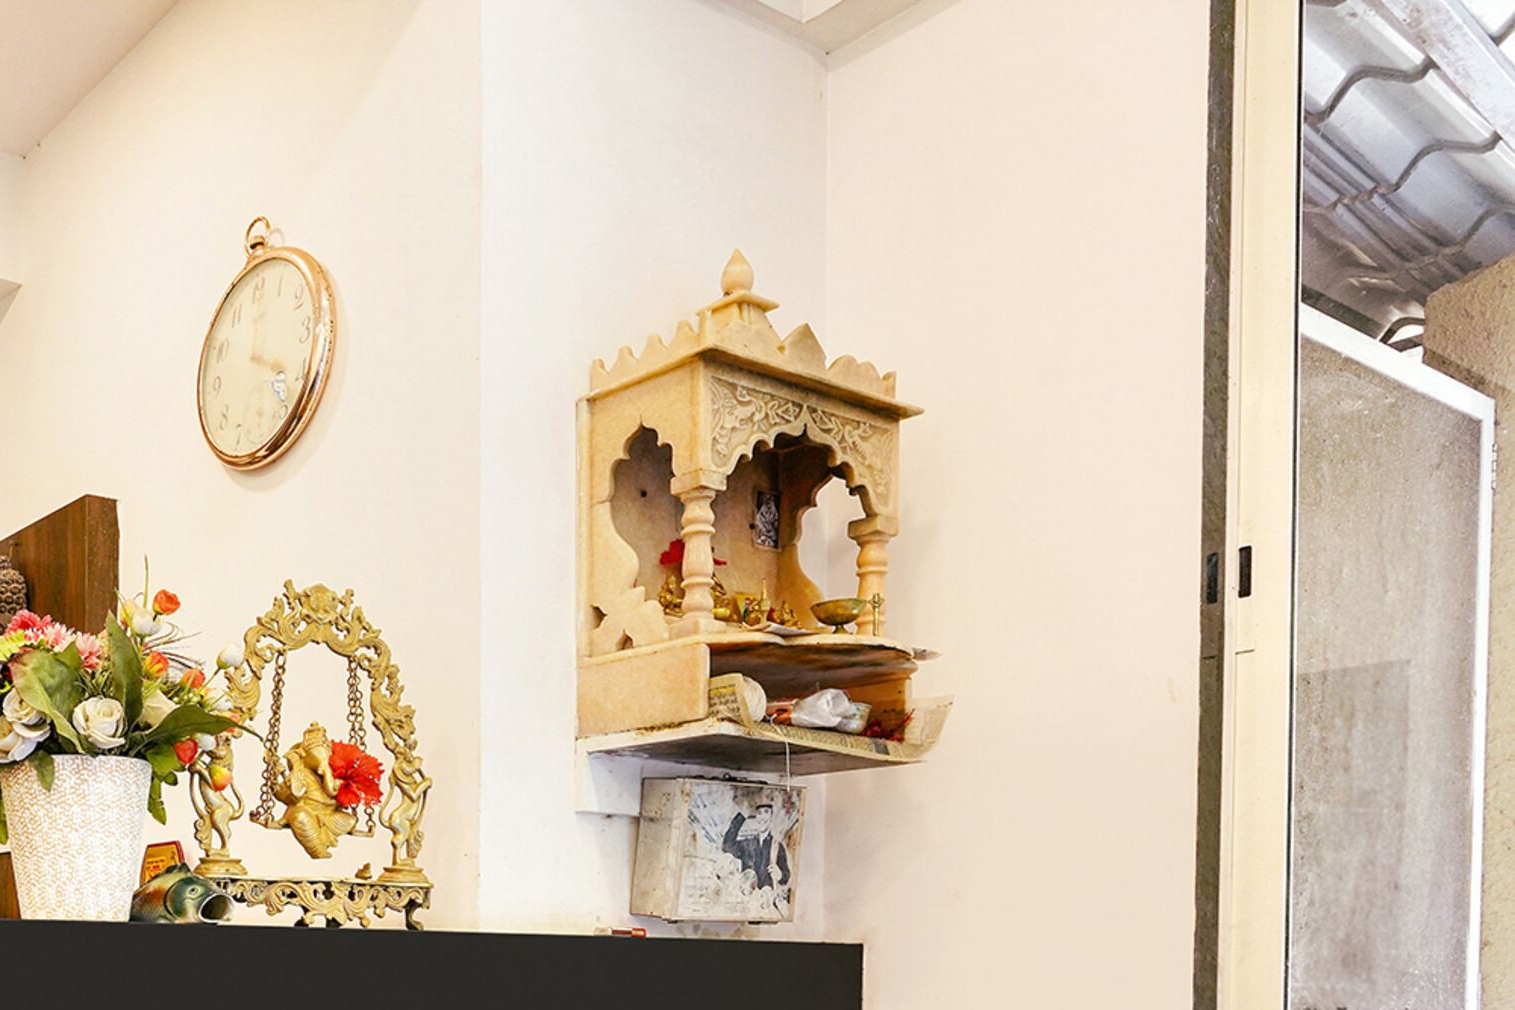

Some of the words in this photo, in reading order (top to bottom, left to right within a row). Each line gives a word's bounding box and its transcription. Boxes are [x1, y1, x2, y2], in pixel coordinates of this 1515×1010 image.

[299, 315, 311, 344] 3
[212, 375, 222, 398] 9
[219, 404, 229, 431] 8
